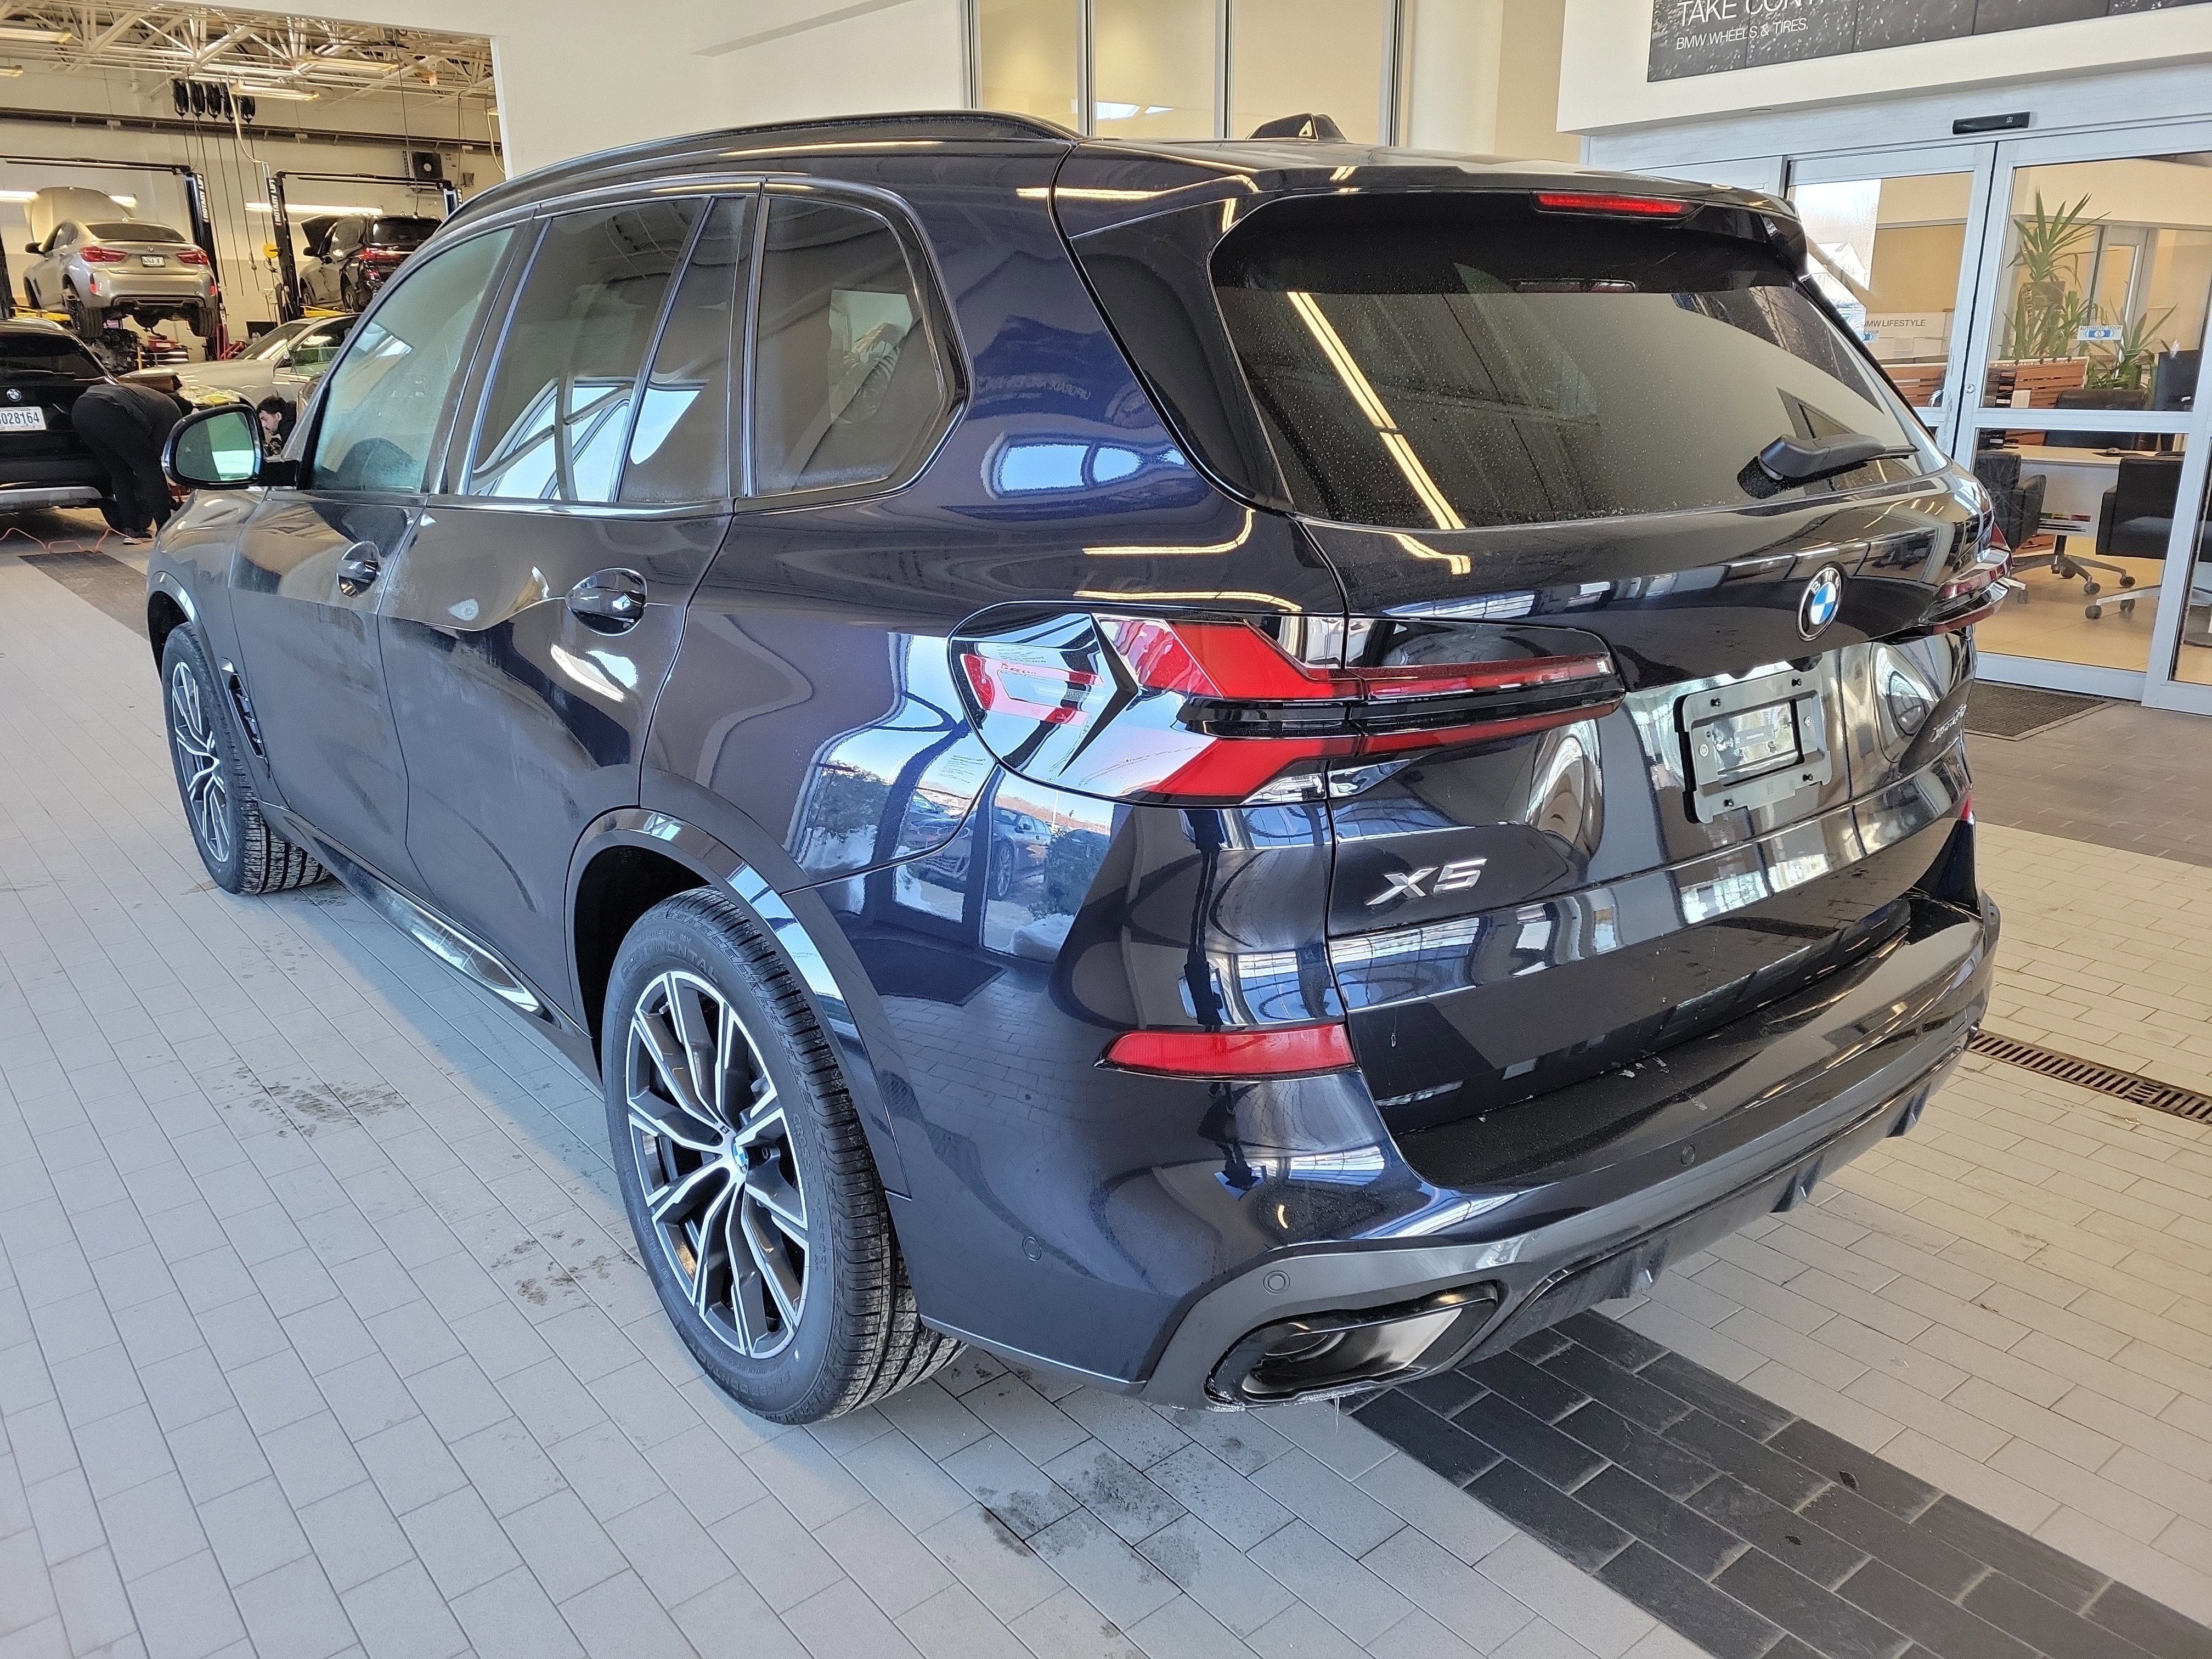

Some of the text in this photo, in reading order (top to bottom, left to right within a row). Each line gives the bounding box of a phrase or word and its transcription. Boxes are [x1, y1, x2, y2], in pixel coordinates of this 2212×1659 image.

[1677, 0, 1737, 26] TAKE
[1677, 33, 1707, 50] BMW
[1709, 25, 1758, 44] WHEELS
[1760, 22, 1770, 37] &
[268, 179, 281, 222] ROTARY LIFT
[0, 411, 40, 425] 028164
[1366, 858, 1487, 906] X5
[620, 940, 719, 984] CONTINENTAL
